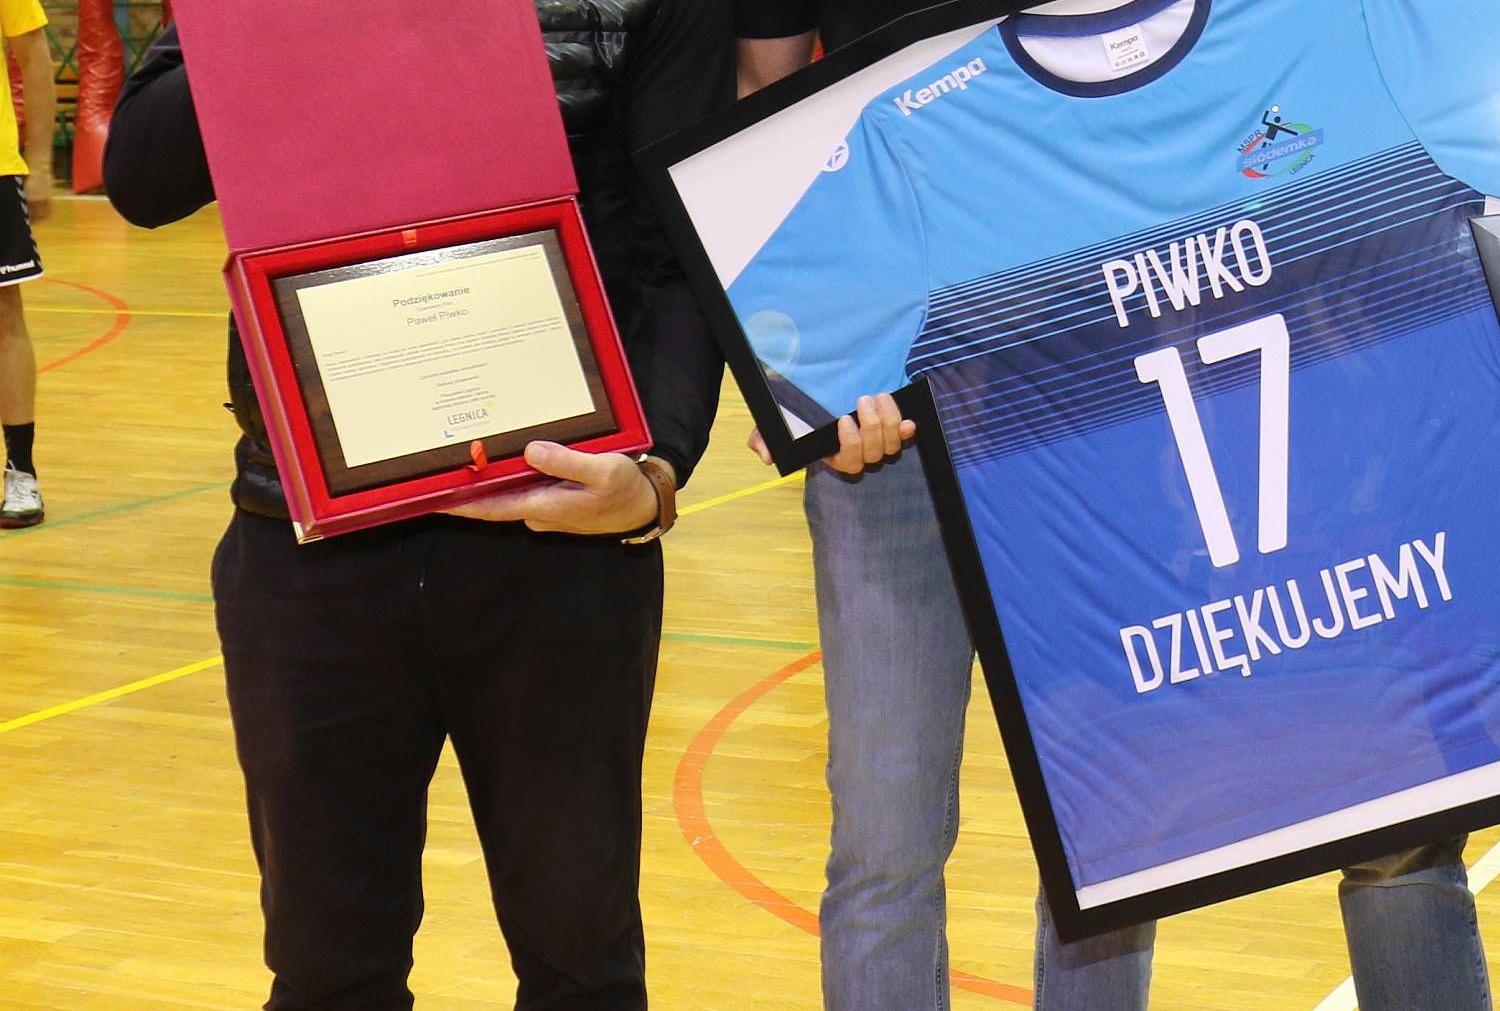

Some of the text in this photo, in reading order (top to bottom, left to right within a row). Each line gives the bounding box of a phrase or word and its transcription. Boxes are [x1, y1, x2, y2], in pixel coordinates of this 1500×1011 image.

[893, 55, 988, 118] Kempa
[1101, 219, 1273, 328] PIWKO
[447, 408, 489, 426] LEGNICA
[1133, 312, 1290, 568] 17
[1119, 531, 1454, 694] DZIĘKUJEMY
